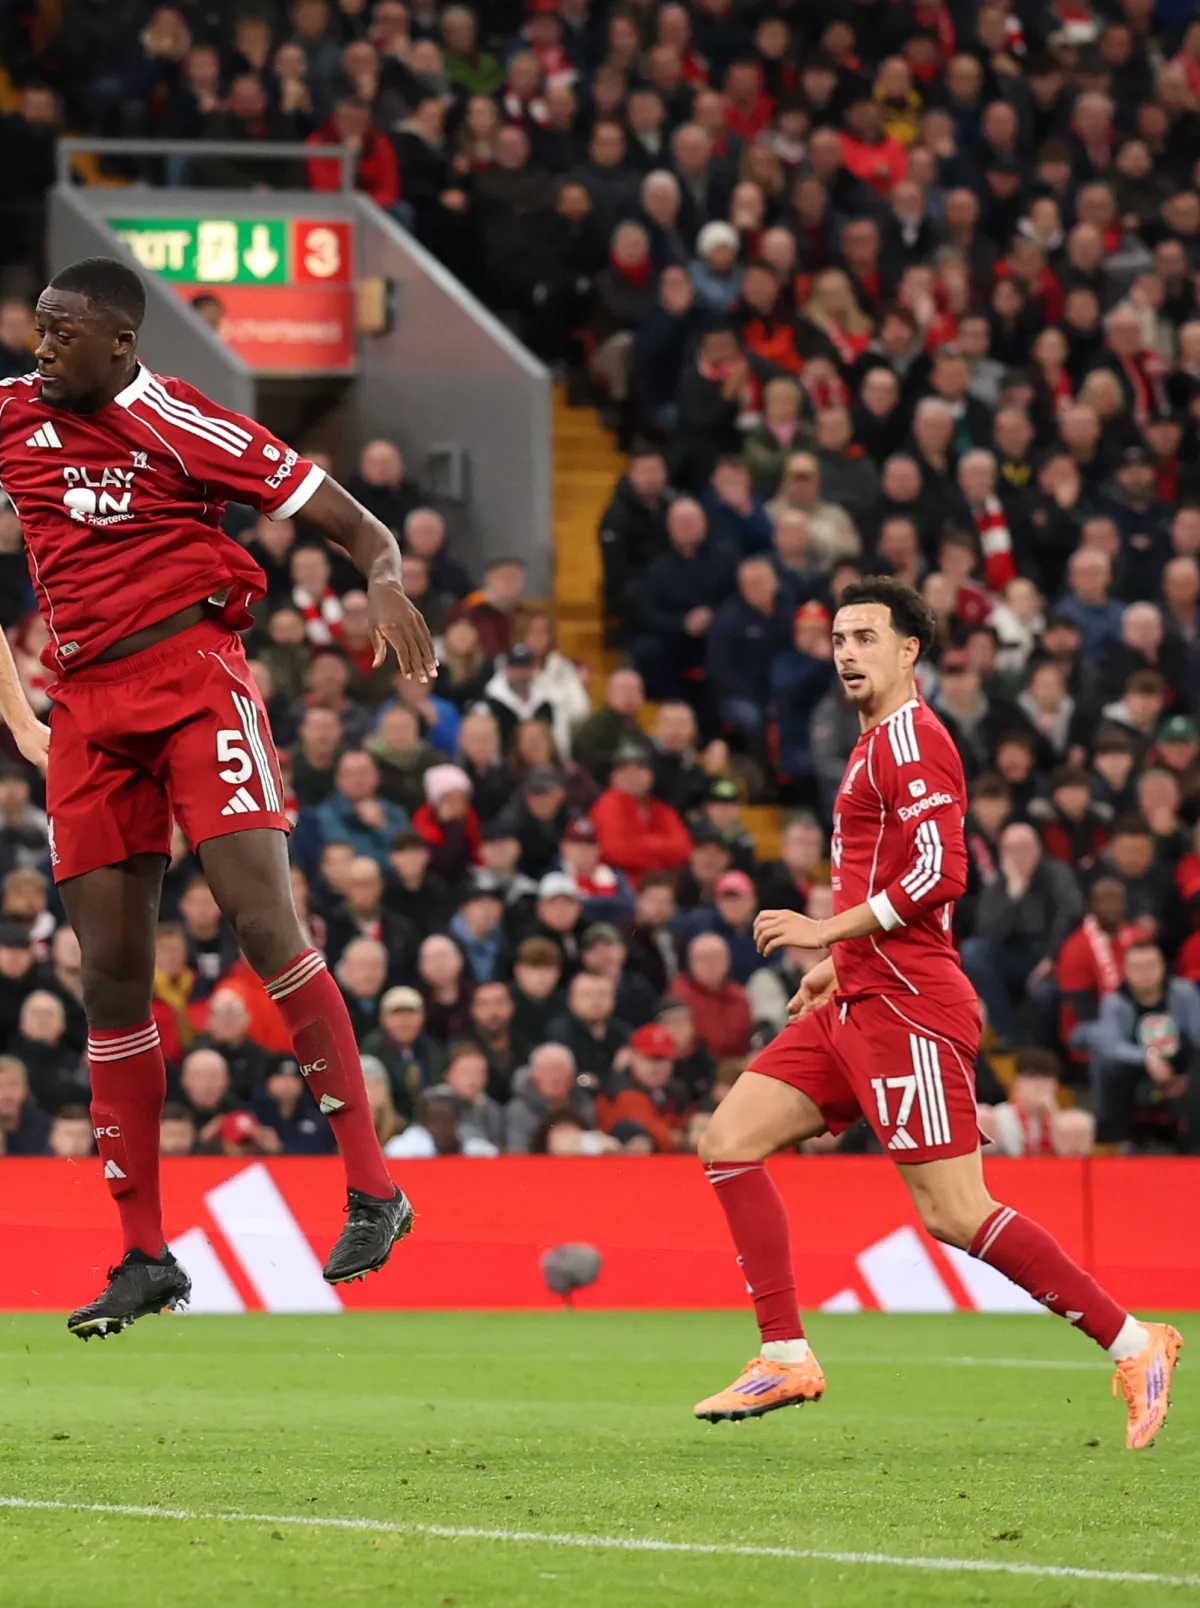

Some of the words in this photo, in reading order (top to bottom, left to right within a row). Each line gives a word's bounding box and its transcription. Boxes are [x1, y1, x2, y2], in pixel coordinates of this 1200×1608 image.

[119, 229, 192, 270] XIT
[304, 227, 341, 278] 3
[63, 466, 135, 489] PLAY
[216, 729, 254, 784] 5
[897, 792, 953, 822] Expedia
[870, 1075, 917, 1126] 17
